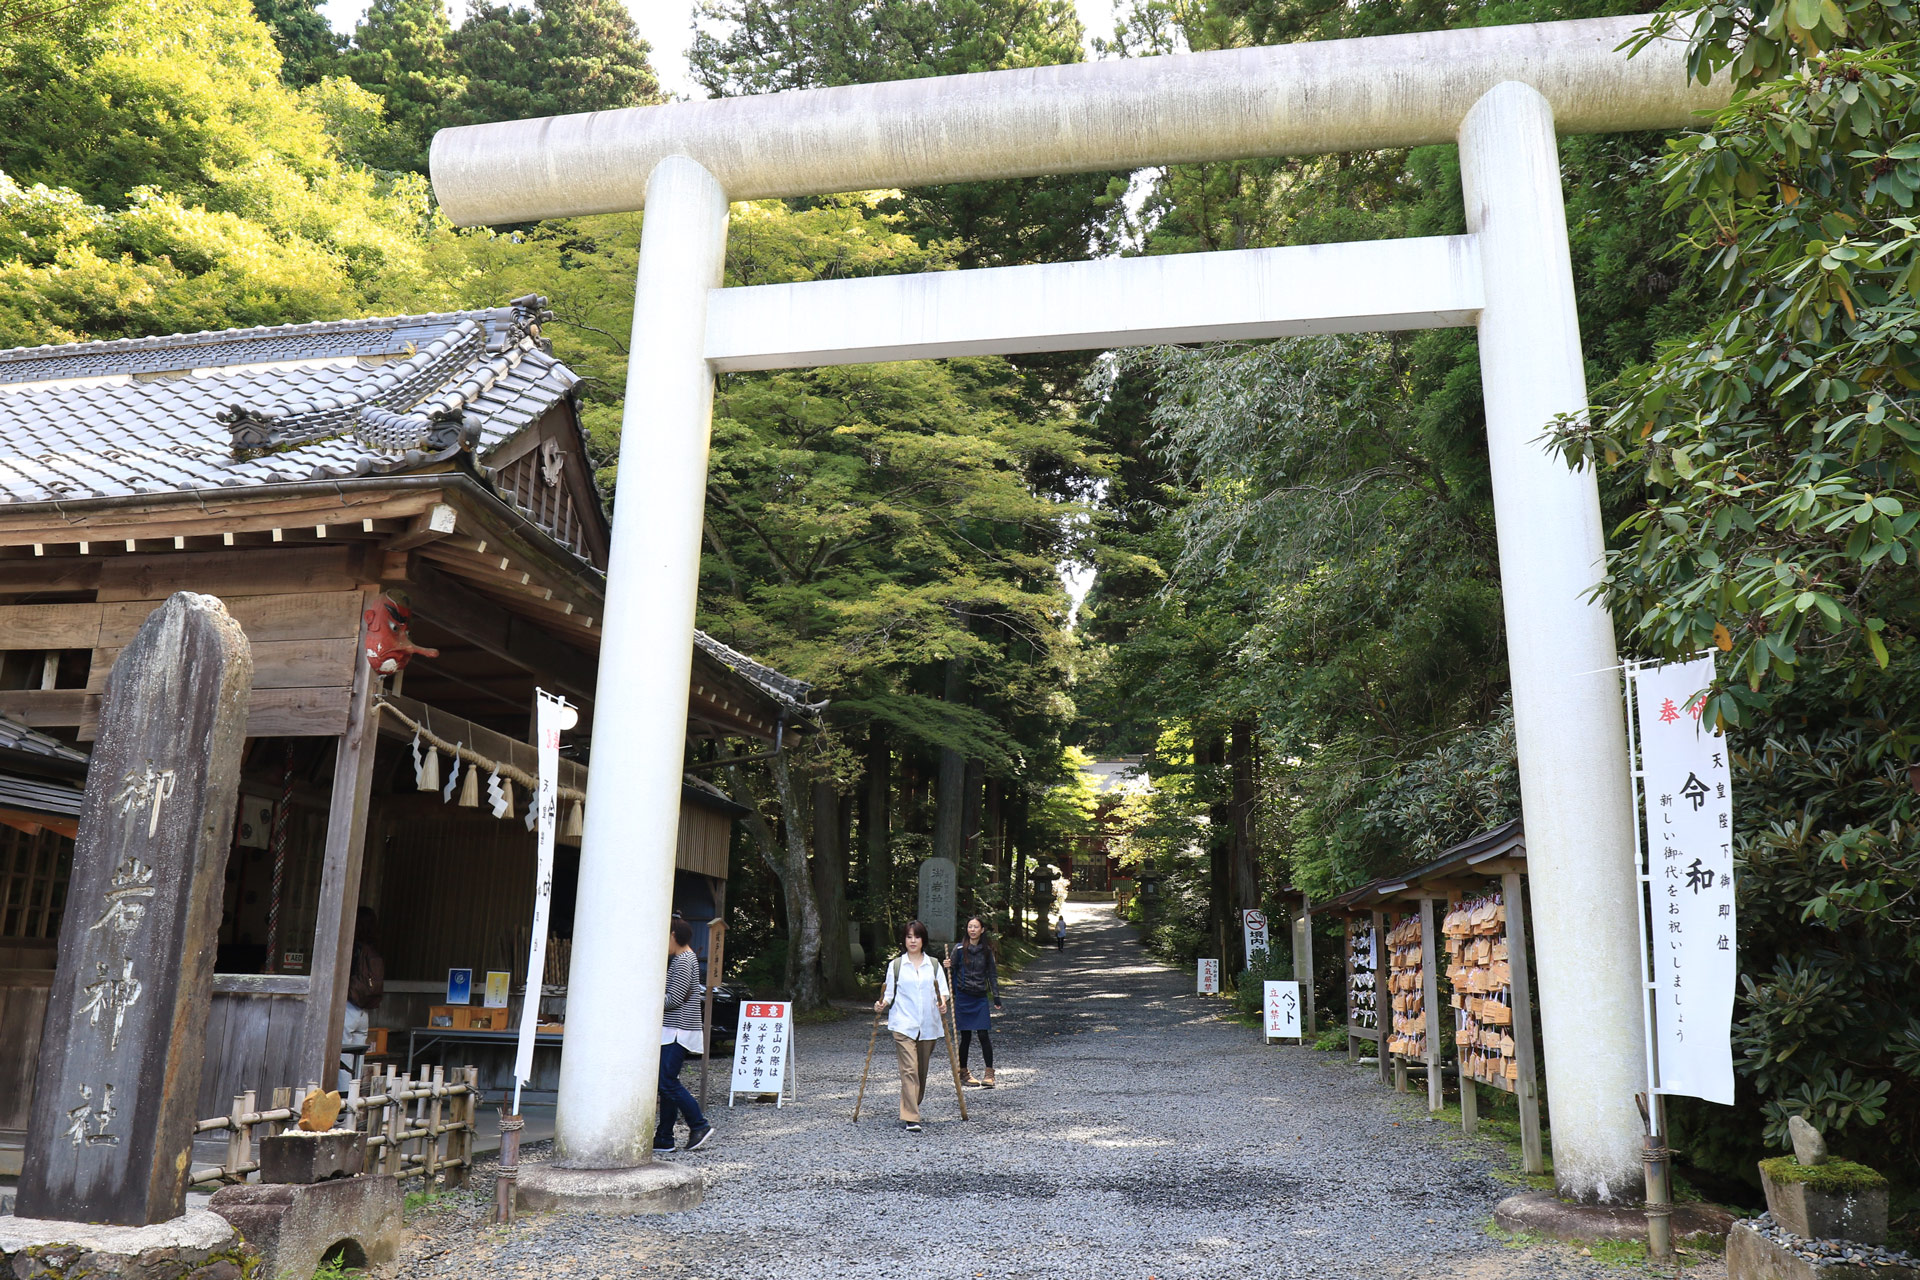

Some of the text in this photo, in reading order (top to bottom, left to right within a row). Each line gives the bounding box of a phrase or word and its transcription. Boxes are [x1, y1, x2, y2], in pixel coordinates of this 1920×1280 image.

[1679, 771, 1715, 895] 令和
[1712, 752, 1731, 951] 天皇陛下御即位
[930, 867, 944, 917] 御岩神社
[1660, 793, 1684, 1043] 新しい御代をお祝いしましょう
[60, 758, 176, 1148] 御岩神社
[290, 954, 303, 962] AED
[751, 1005, 778, 1017] 注意
[1269, 988, 1281, 1031] 立入禁止
[1282, 990, 1296, 1025] ペット
[738, 1021, 752, 1076] 持参下さい
[753, 1023, 768, 1089] 必ず飲み物を
[769, 1022, 783, 1077] 登山の際は
